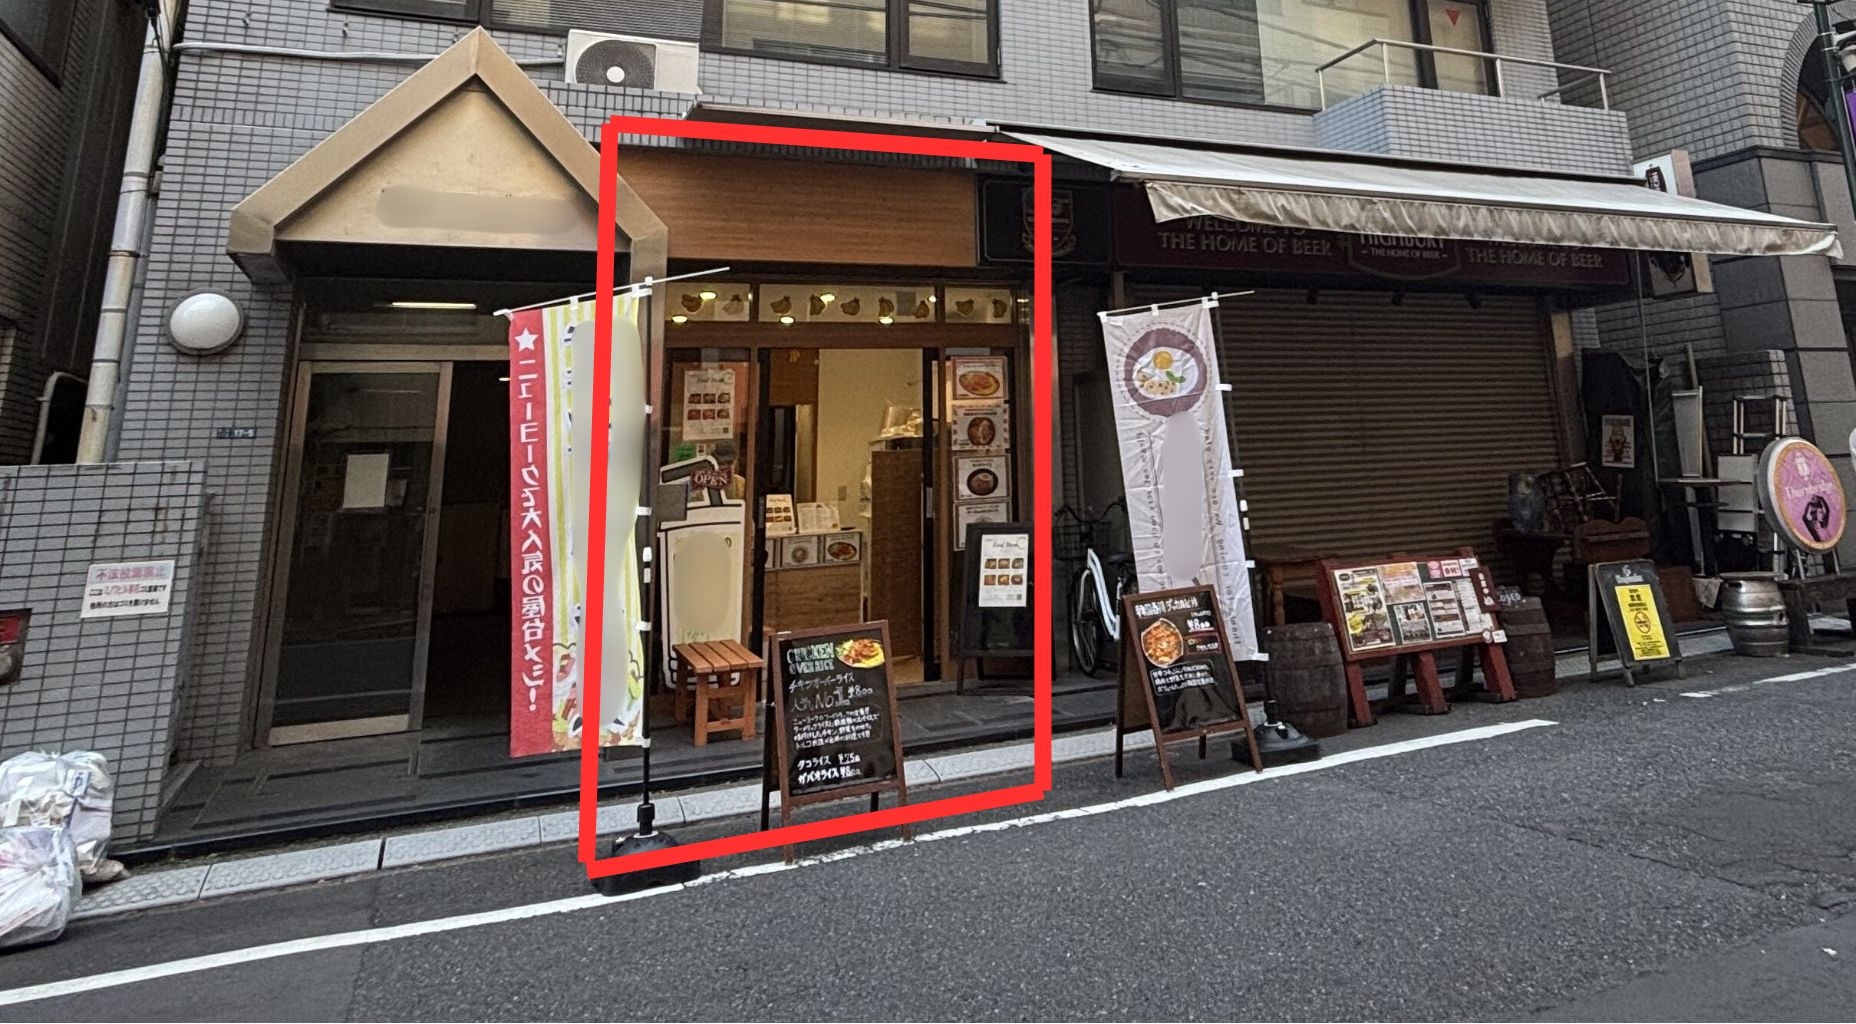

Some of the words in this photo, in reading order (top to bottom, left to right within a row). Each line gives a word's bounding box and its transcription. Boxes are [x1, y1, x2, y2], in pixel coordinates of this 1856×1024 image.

[1159, 232, 1196, 250] THE
[1201, 234, 1258, 253] HOME
[1263, 237, 1286, 254] OF
[1293, 238, 1332, 256] BEER
[1371, 247, 1385, 256] THE
[1387, 249, 1409, 257] HOME
[1466, 247, 1497, 265] THE
[1500, 249, 1544, 266] HOME
[1548, 252, 1568, 267] OF
[1572, 253, 1603, 268] BEER
[694, 470, 729, 487] OPEN
[797, 755, 832, 771] タコライス
